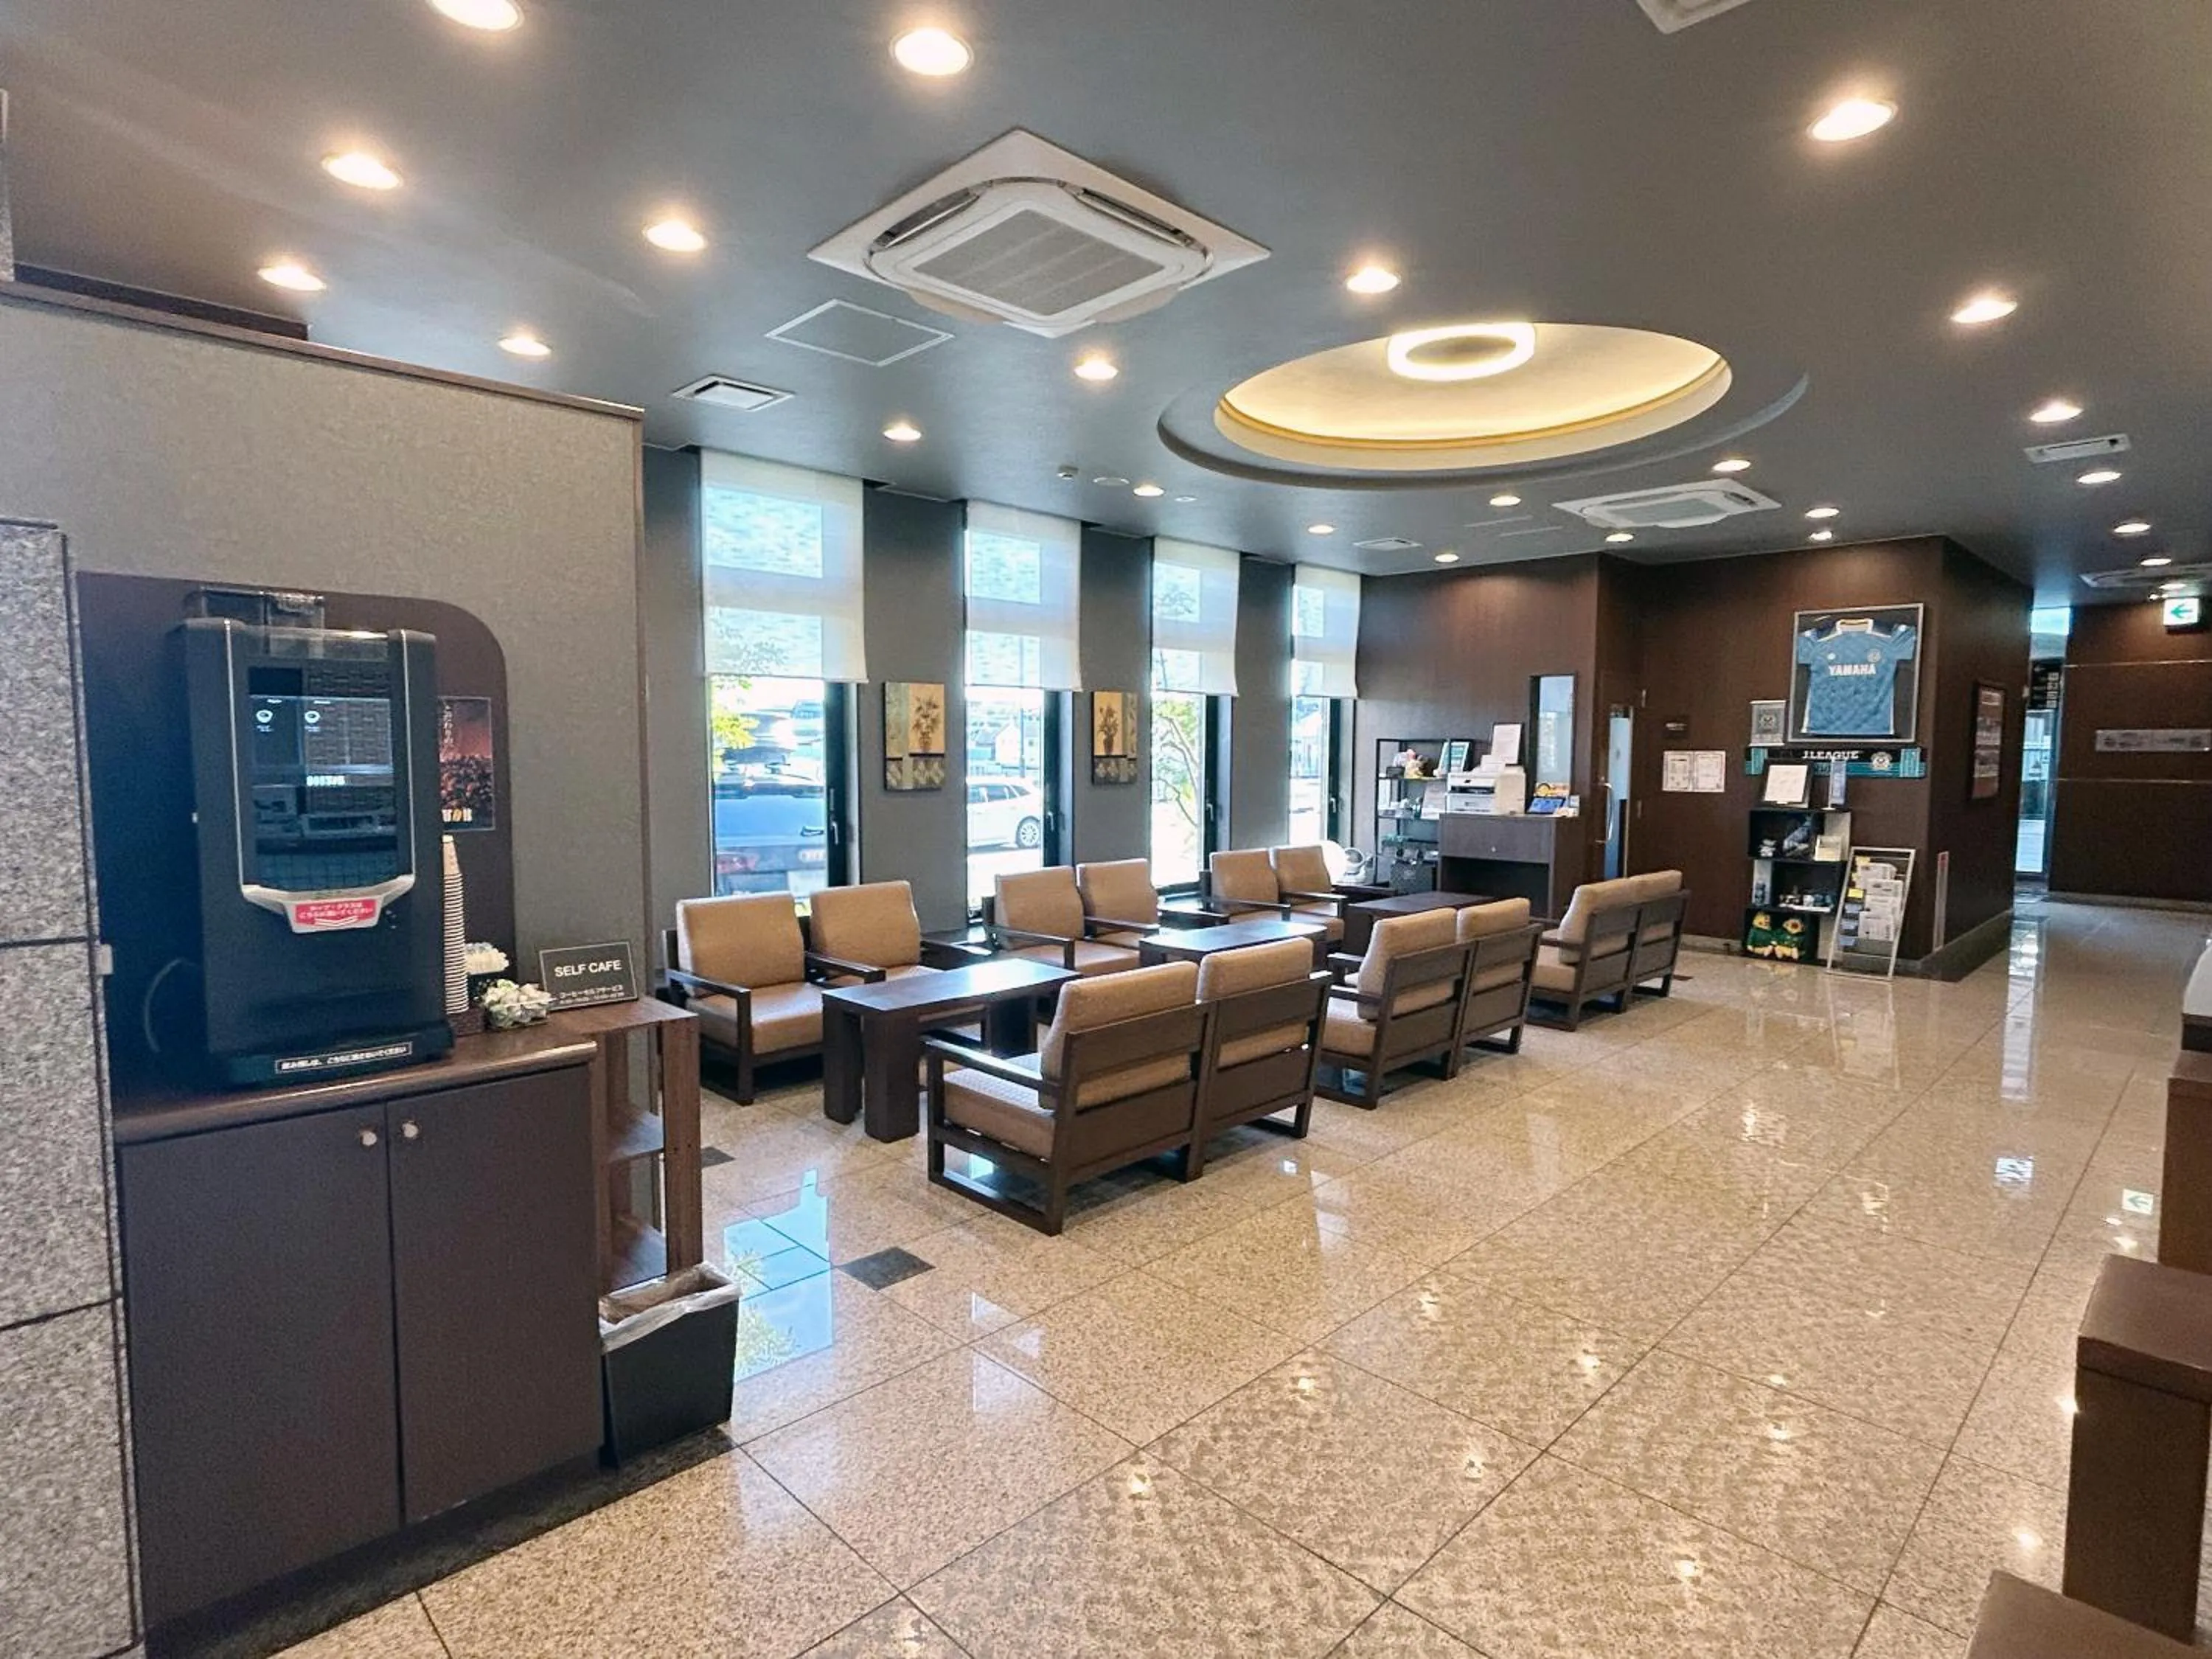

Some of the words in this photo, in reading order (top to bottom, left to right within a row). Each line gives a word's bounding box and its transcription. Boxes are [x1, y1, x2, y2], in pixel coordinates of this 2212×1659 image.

[1829, 664, 1876, 676] YAMAHA
[554, 964, 586, 977] SELF
[588, 959, 622, 973] CAFE
